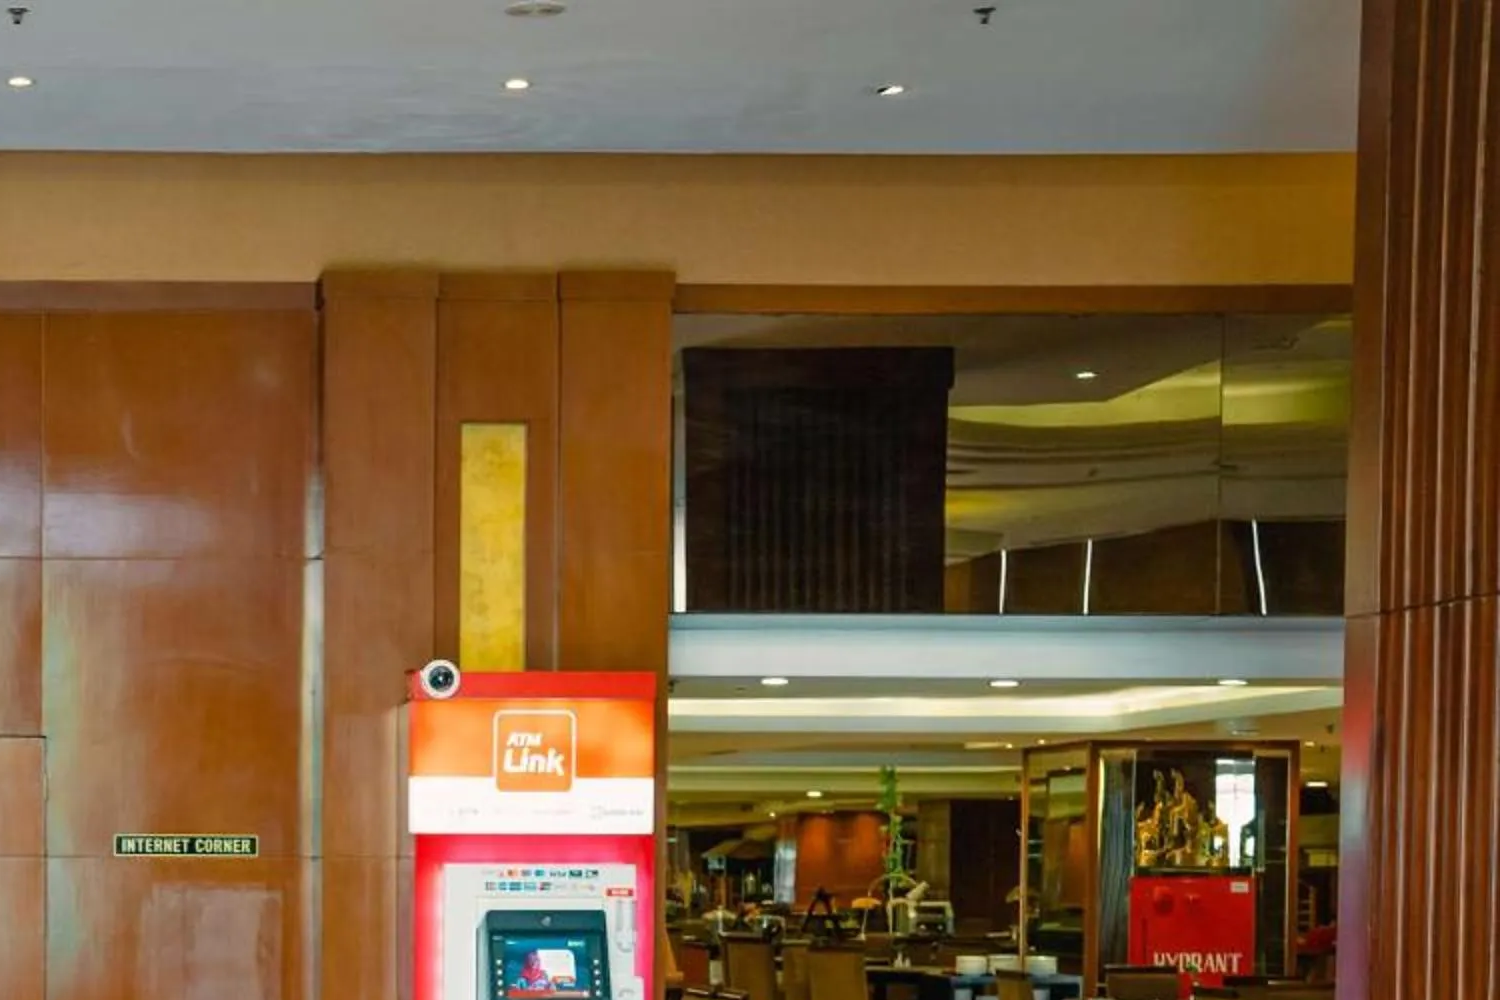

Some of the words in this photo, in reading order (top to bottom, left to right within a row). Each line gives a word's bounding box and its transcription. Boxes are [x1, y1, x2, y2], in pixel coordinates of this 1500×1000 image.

[506, 732, 543, 747] ATM
[503, 747, 565, 776] Link
[121, 837, 190, 853] INTERNET
[195, 838, 251, 853] CORNER
[1153, 951, 1242, 973] HYDRANT
